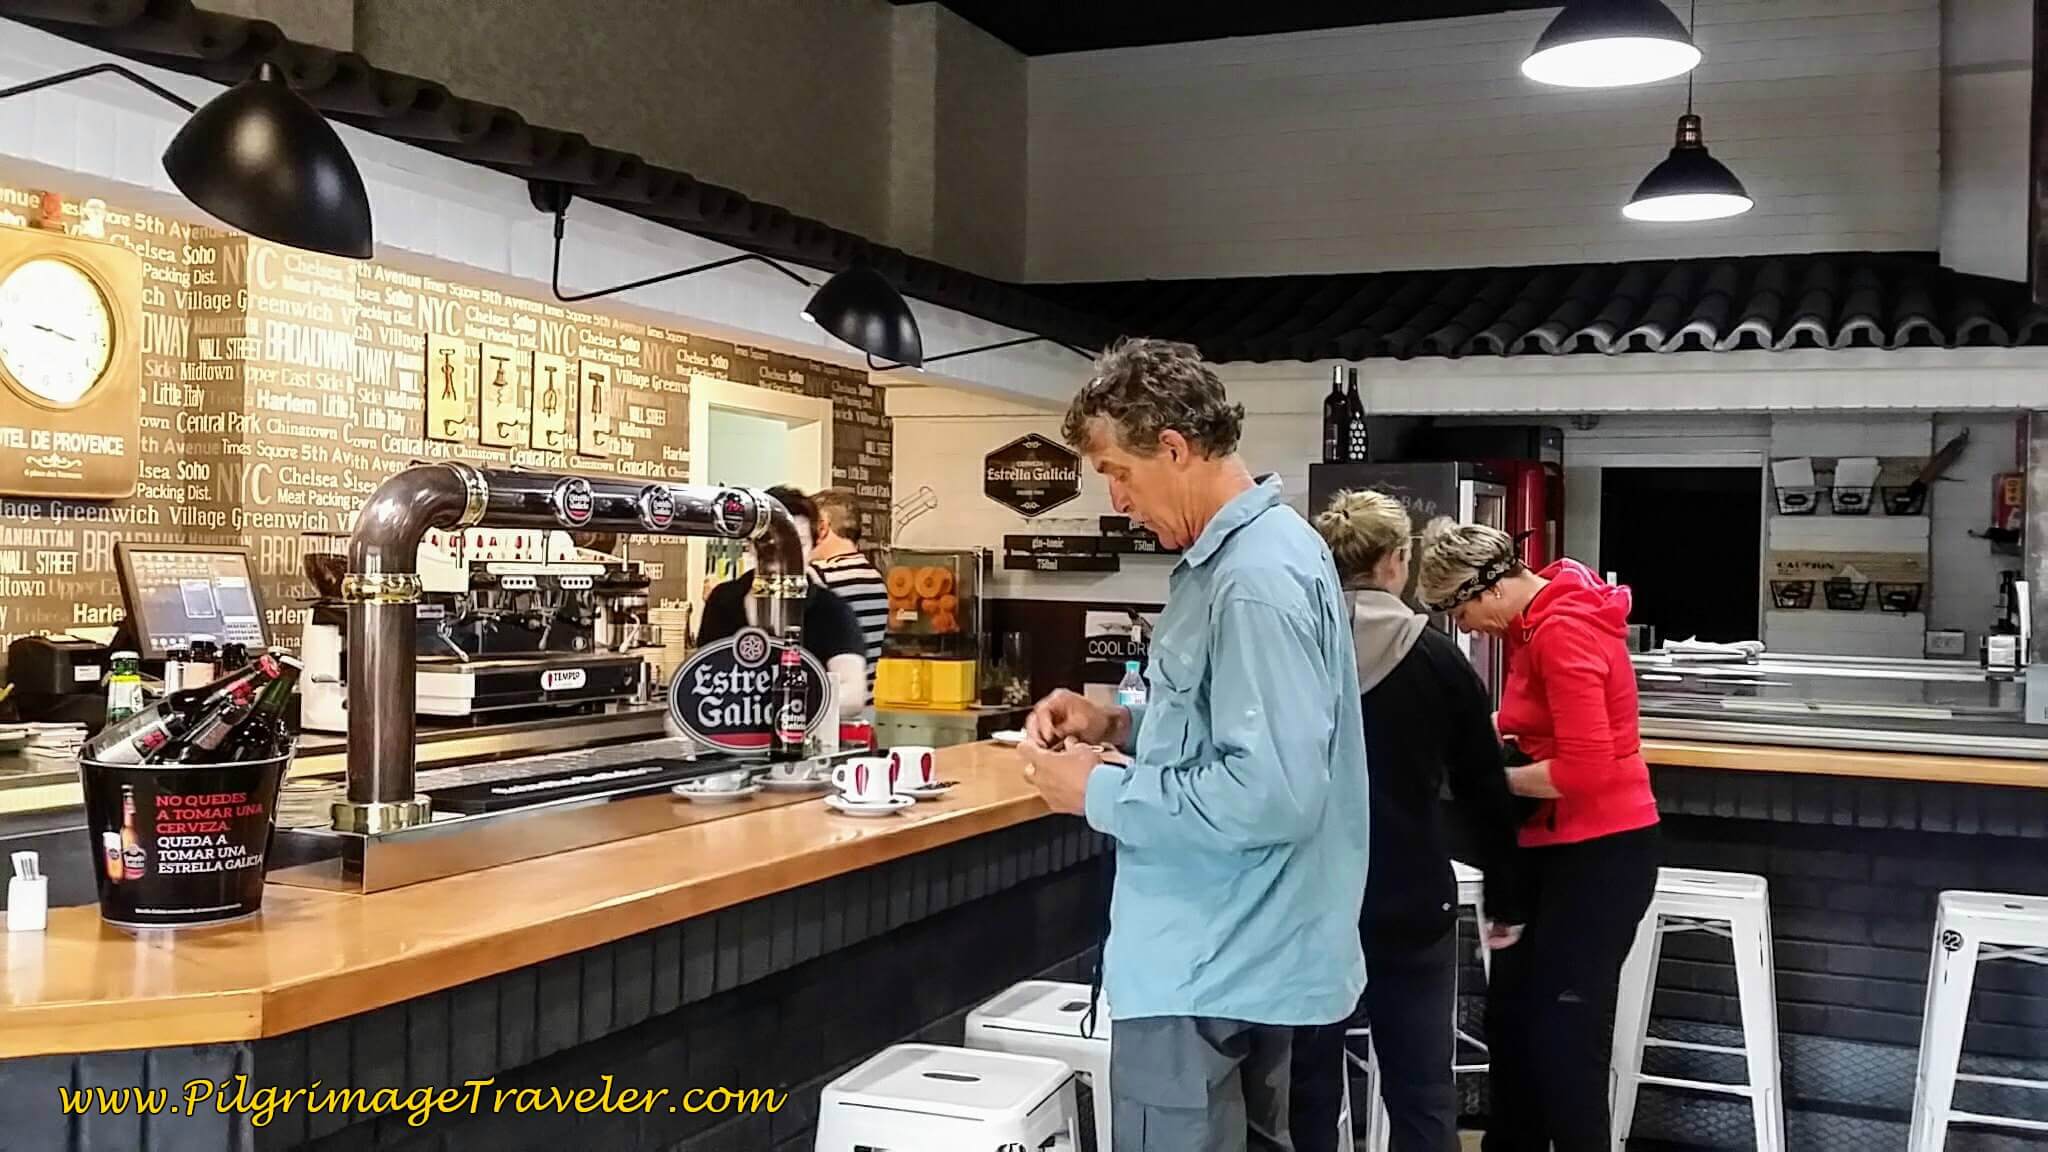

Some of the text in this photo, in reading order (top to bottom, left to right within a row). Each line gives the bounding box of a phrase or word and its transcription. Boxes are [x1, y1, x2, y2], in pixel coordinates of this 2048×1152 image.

[134, 213, 164, 235] 5th
[182, 245, 215, 265] Soho
[143, 262, 217, 287] Packing Dist.
[222, 244, 278, 289] NYC
[174, 289, 231, 313] Village
[236, 289, 333, 322] Greenwich
[418, 294, 462, 337] NYC
[465, 305, 510, 328] Chelsea
[198, 336, 263, 360] WALL STREET
[541, 319, 577, 357] NYC
[580, 328, 617, 349] Chelsea
[180, 362, 234, 381] Midtown
[153, 380, 182, 407] Little
[184, 384, 204, 412] Italy
[257, 388, 317, 415] Harlem
[177, 411, 225, 434] Central
[228, 411, 261, 435] Park
[266, 418, 338, 440] Chinatown
[0, 427, 125, 456] TEL DE PROVENCE
[222, 438, 252, 455] Times
[256, 440, 298, 461] Square
[301, 444, 328, 463] 5th
[381, 433, 424, 457] Central
[176, 459, 210, 480] Soho
[278, 467, 338, 488] Chelsea
[987, 466, 1076, 481] Estrella Galicia
[137, 482, 212, 503] Packing Dist.
[217, 463, 273, 505] NYC
[277, 488, 351, 511] Meat Packing
[50, 501, 159, 526] Greenwich
[169, 504, 226, 530] Village
[231, 507, 328, 532] Greenwich
[1032, 537, 1065, 549] gin-tonic
[1134, 540, 1155, 552] 750ml
[36, 550, 79, 576] STREET
[1037, 559, 1058, 570] 750ml
[1776, 560, 1834, 570] CAUTION
[73, 603, 127, 624] Harle
[1088, 640, 1125, 655] COOL
[156, 792, 247, 807] NO QUEDES
[156, 803, 263, 820] A TOMAR UNA
[157, 834, 228, 849] QUEDA A
[158, 849, 215, 861] TOMAR
[218, 845, 247, 859] UNA
[158, 854, 263, 874] ESTRELLA GALICIA
[1943, 932, 1961, 950] 22
